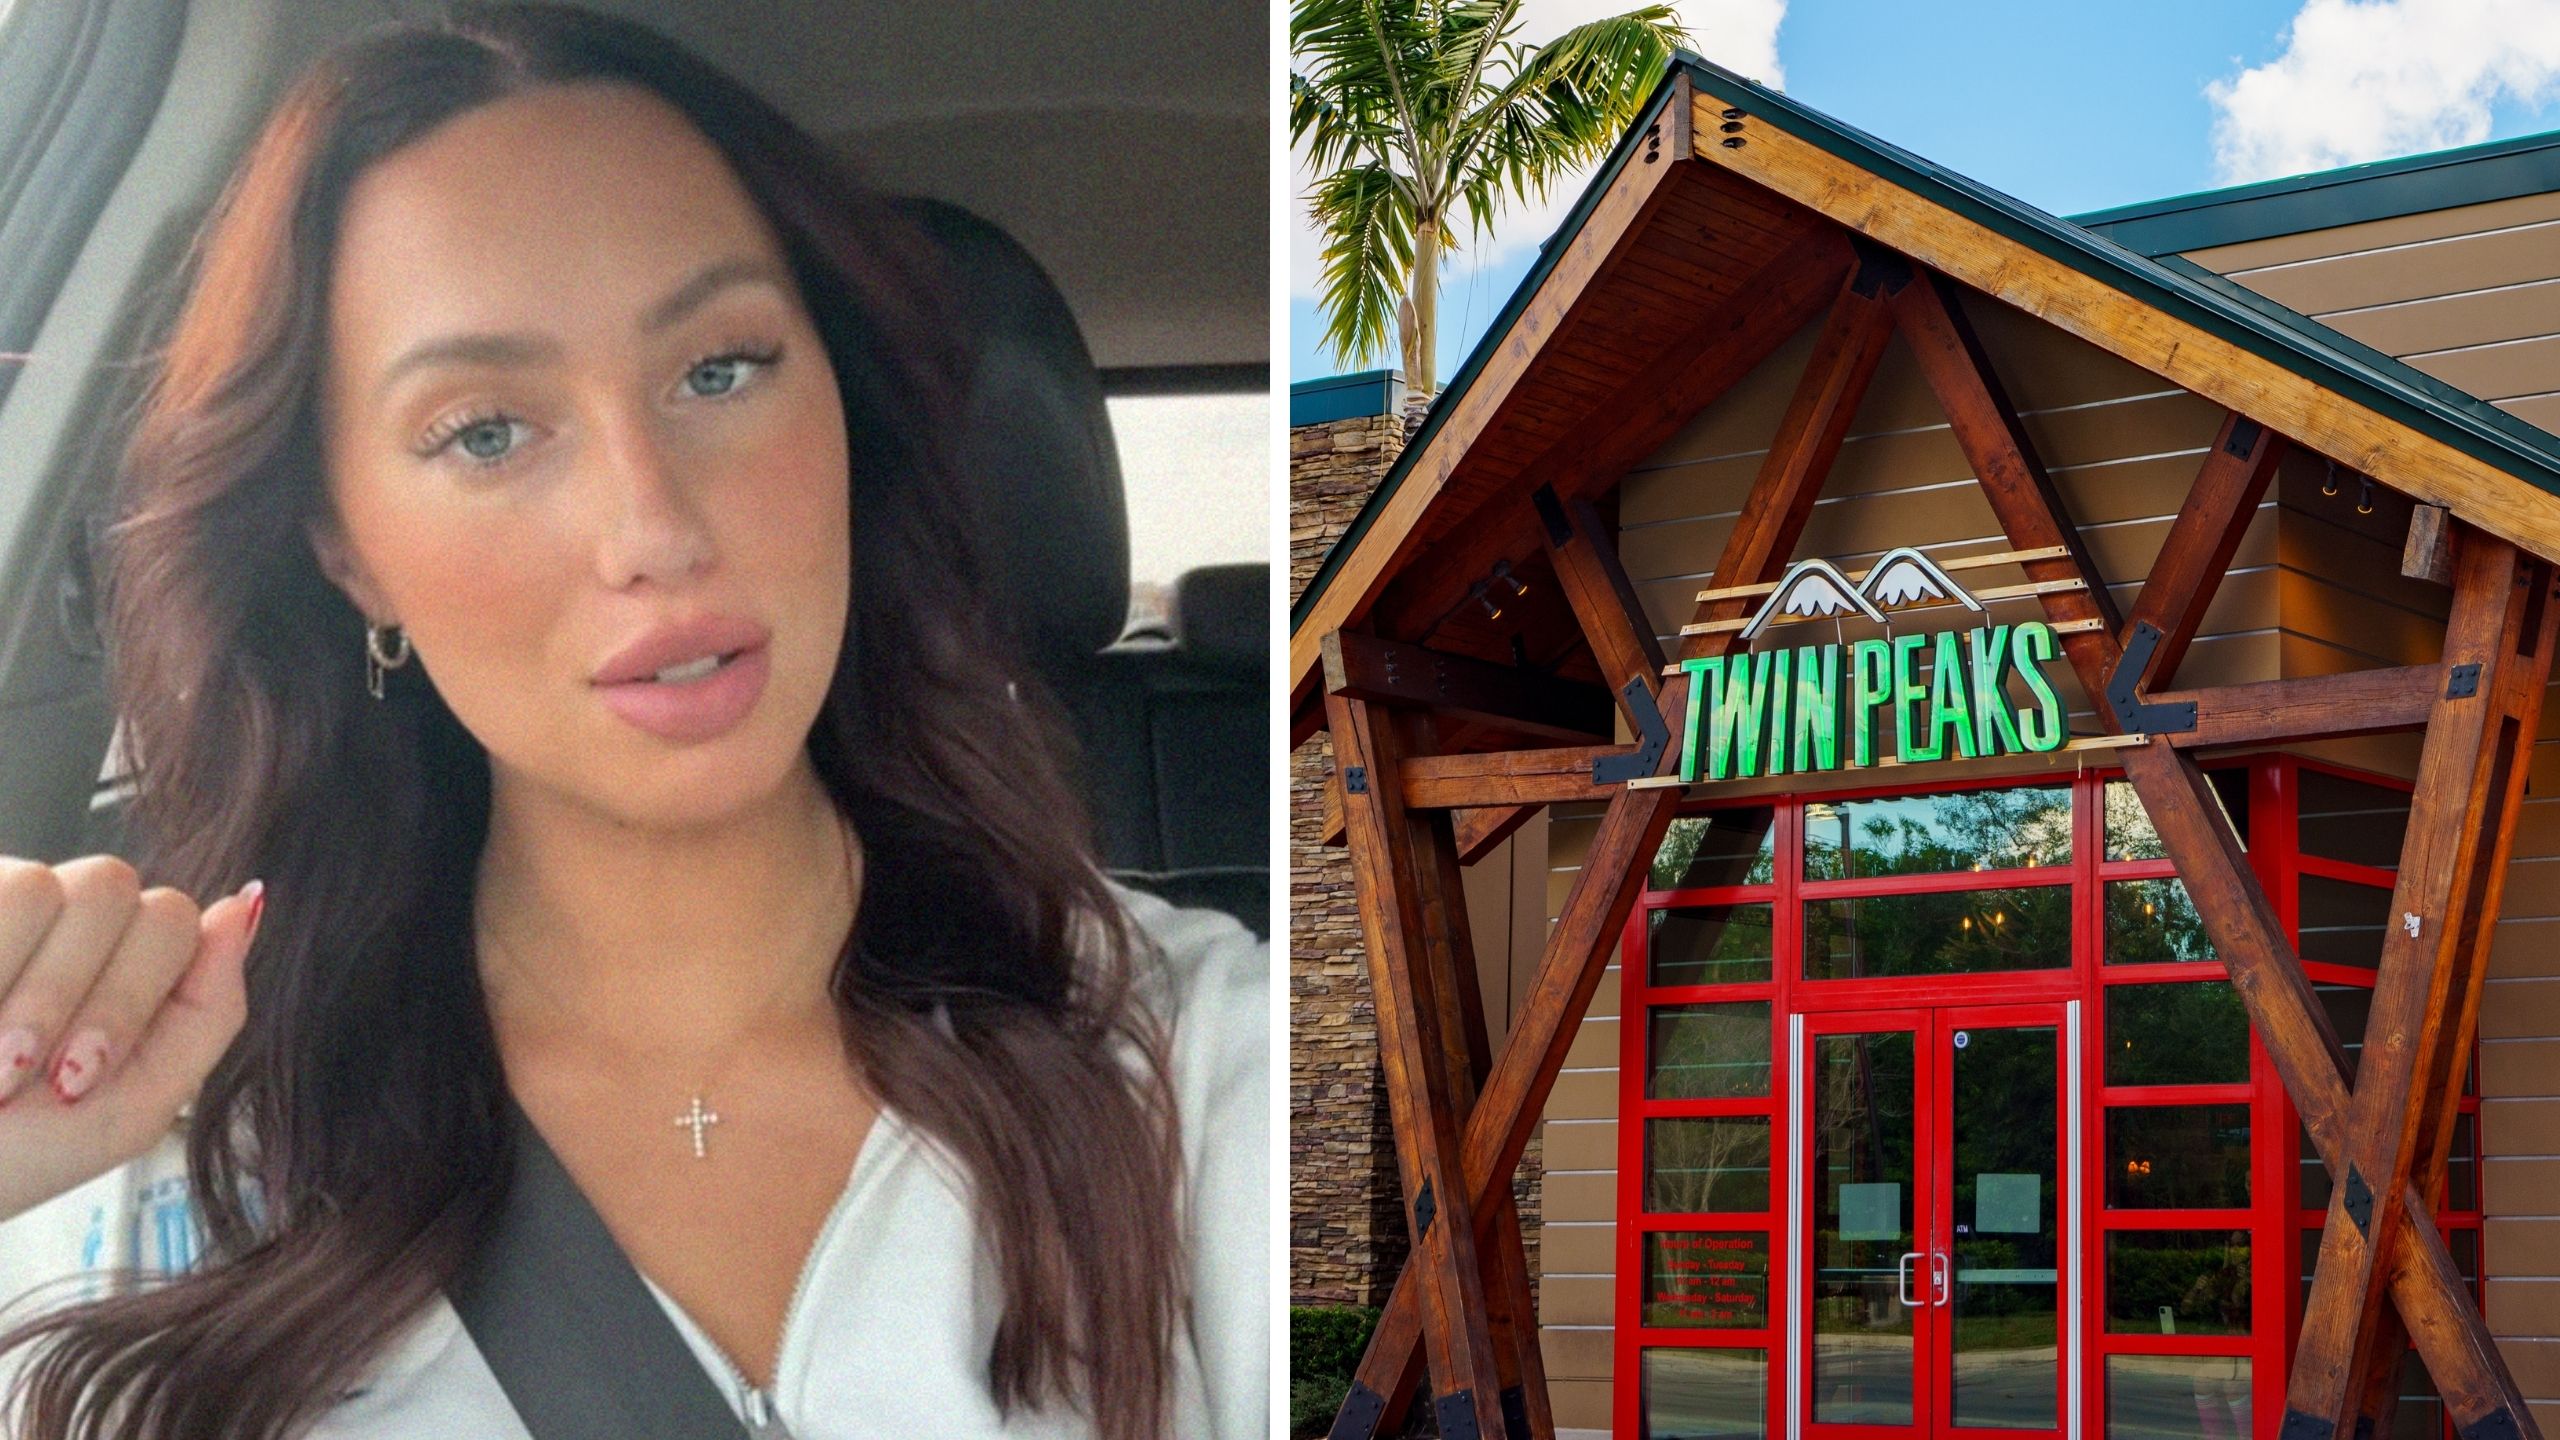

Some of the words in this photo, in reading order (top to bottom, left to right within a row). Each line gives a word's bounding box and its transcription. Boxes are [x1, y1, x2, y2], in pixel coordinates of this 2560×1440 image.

[1679, 643, 1847, 782] TWIN
[1854, 621, 2070, 767] PEAKS
[1956, 1224, 1968, 1232] ATM
[1660, 1238, 1689, 1249] Hours
[1692, 1238, 1702, 1249] of
[1704, 1238, 1753, 1251] Operation
[1666, 1260, 1700, 1271] Sunday
[1709, 1260, 1745, 1271] Tuesday
[1657, 1291, 1707, 1303] Wednesday
[1715, 1291, 1756, 1304] Saturday
